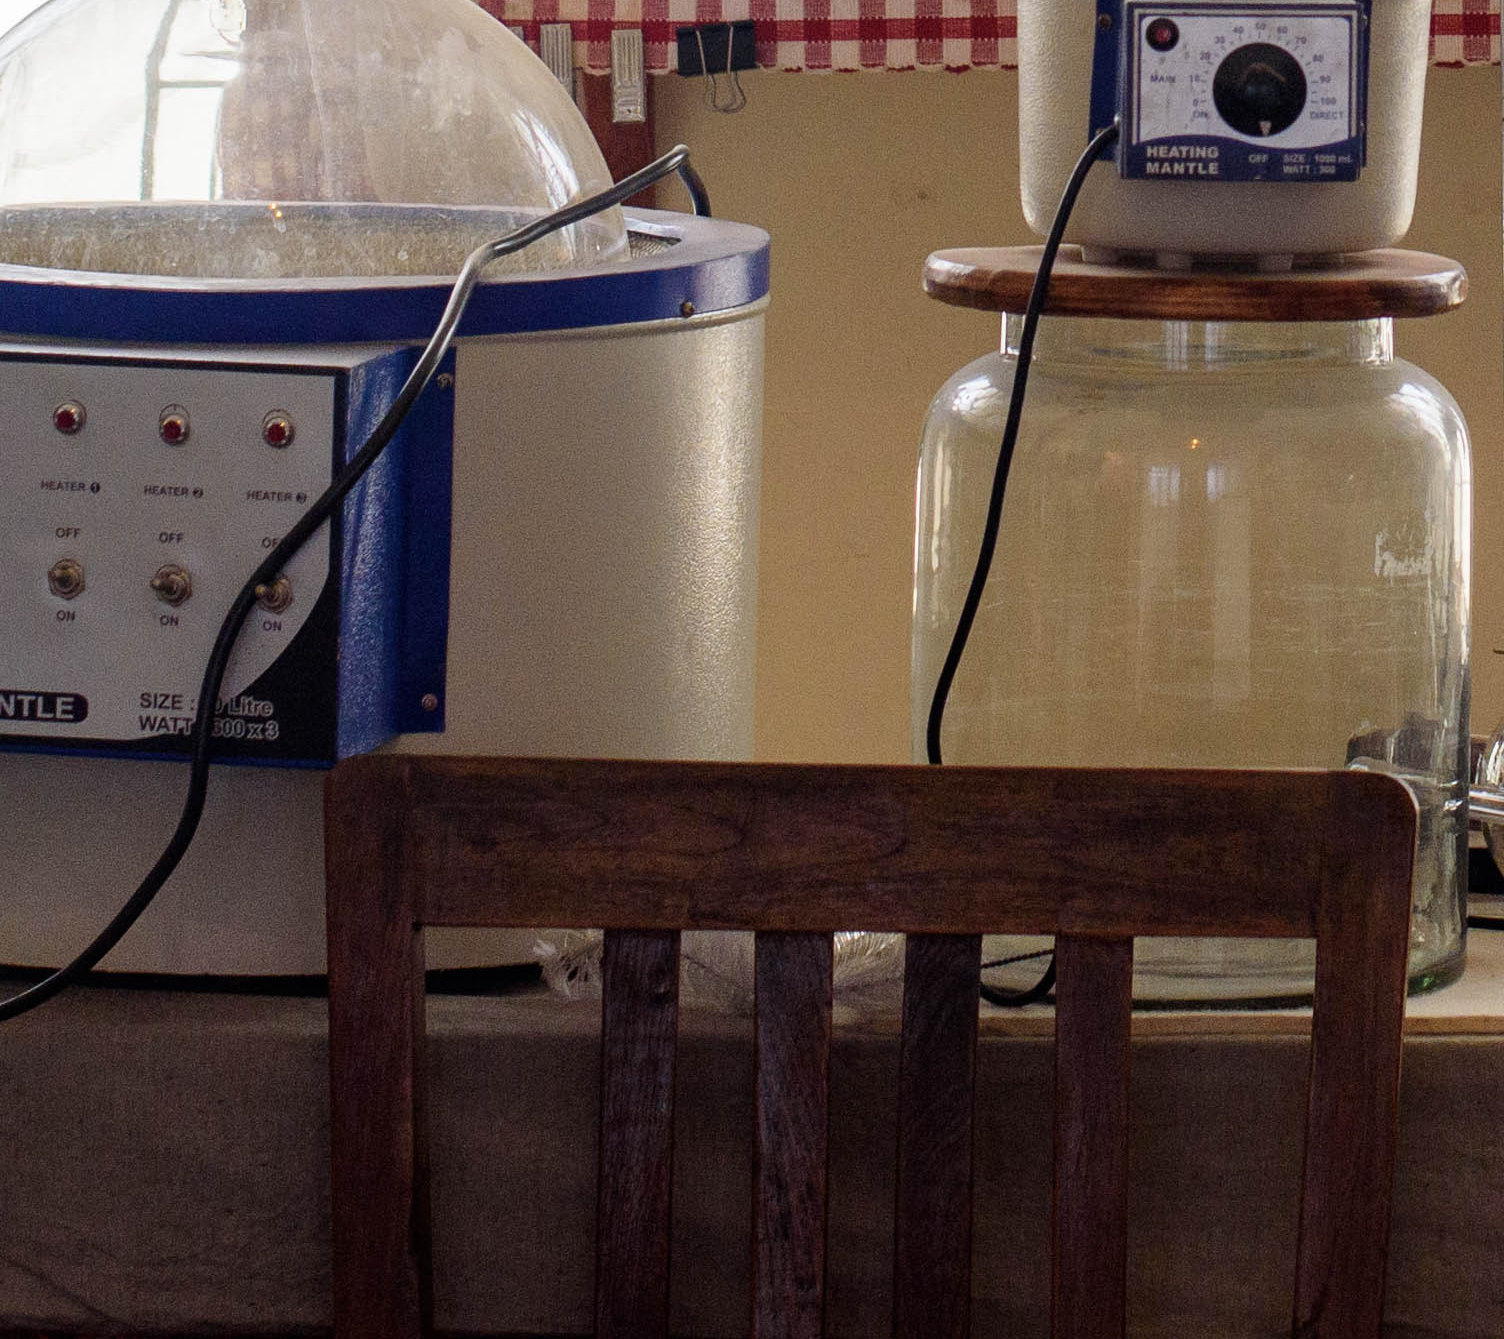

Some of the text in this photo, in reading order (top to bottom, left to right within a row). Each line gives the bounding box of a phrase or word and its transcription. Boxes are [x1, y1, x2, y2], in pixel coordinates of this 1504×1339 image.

[1310, 110, 1344, 120] DIRECT
[1146, 145, 1219, 158] HEATING
[1146, 161, 1219, 175] MANTLE
[40, 480, 86, 492] HEATER
[143, 485, 189, 497] HEATER
[246, 490, 293, 502] HEATER
[55, 527, 81, 539] OFF
[158, 531, 184, 544] OFF
[261, 537, 282, 549] OF
[56, 610, 76, 622] ON
[159, 615, 179, 627] ON
[262, 620, 282, 632] ON
[139, 692, 183, 710] SIZE
[228, 695, 274, 717] Litre
[138, 714, 193, 736] WATT
[265, 720, 280, 741] 3
